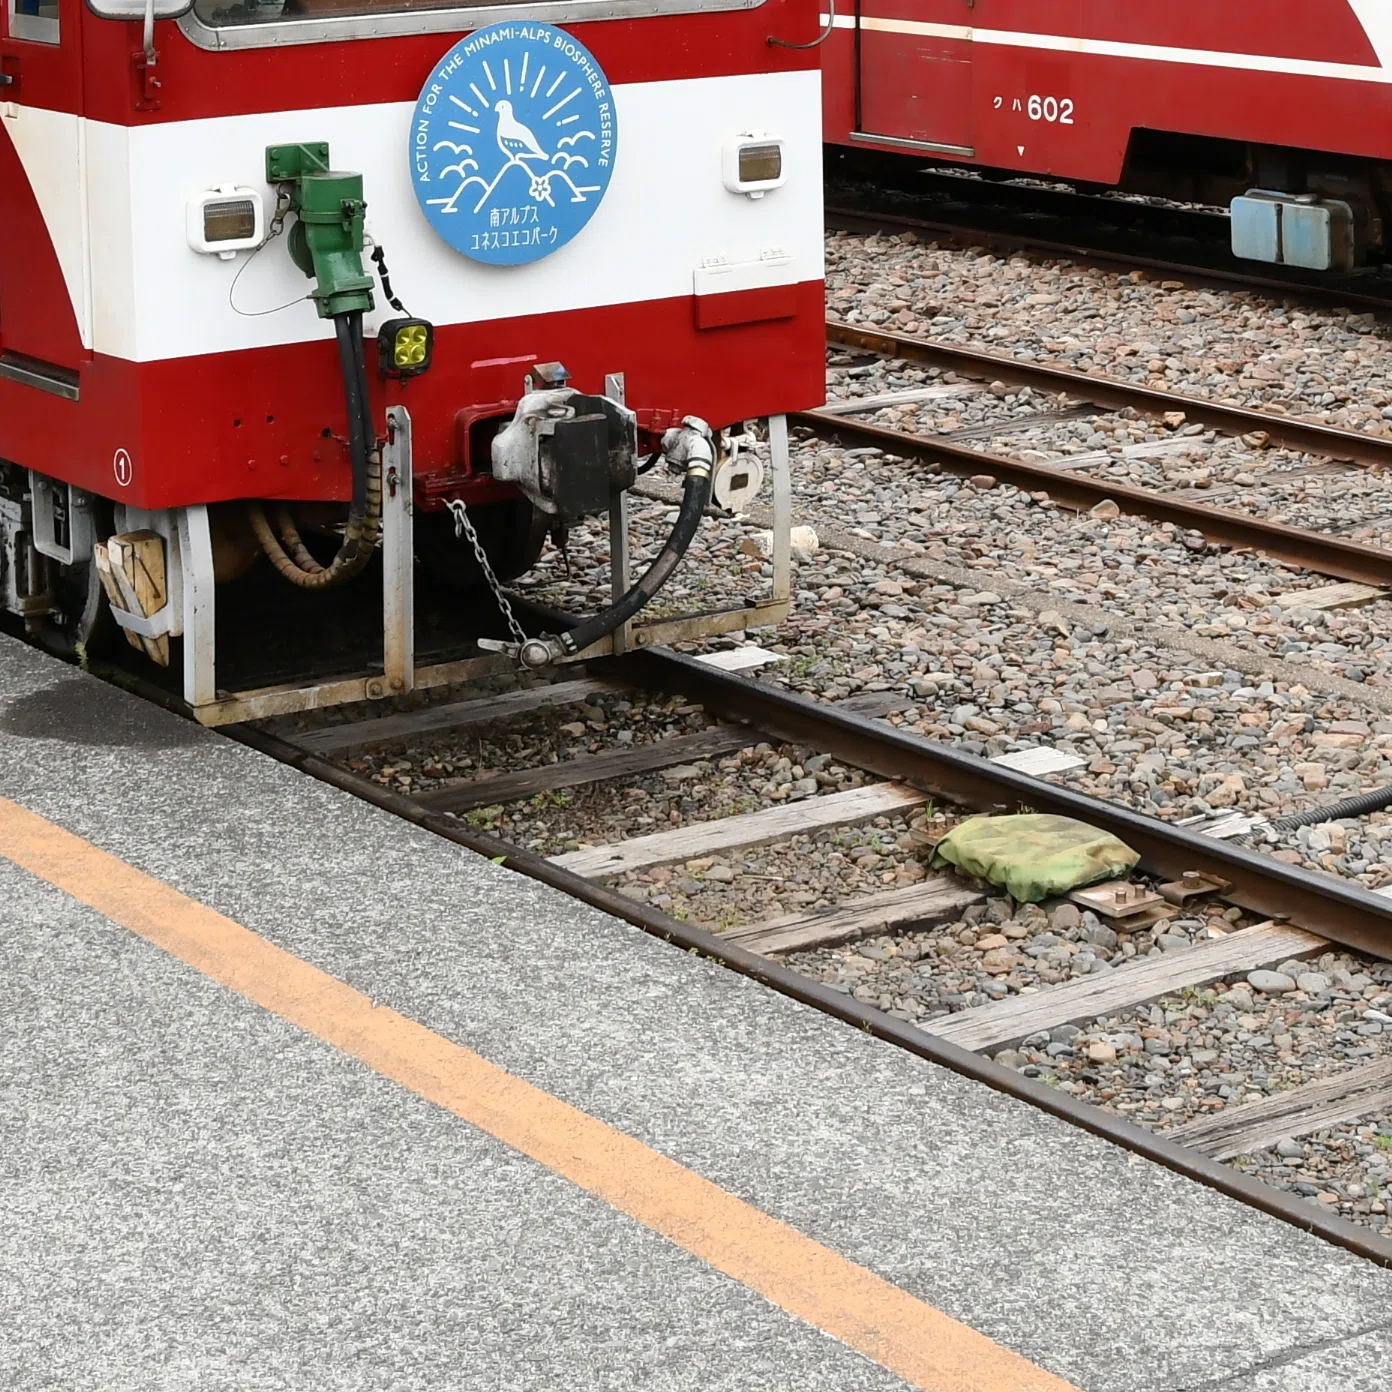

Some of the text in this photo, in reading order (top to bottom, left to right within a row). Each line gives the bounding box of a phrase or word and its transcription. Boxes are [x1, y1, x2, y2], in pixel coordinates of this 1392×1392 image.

[416, 27, 612, 182] ACTION FOR THE MINAMI-ALPS BIOSPHERE RESERVE
[490, 205, 539, 228] 南アルプス
[471, 225, 558, 251] ユネスコエコパーク
